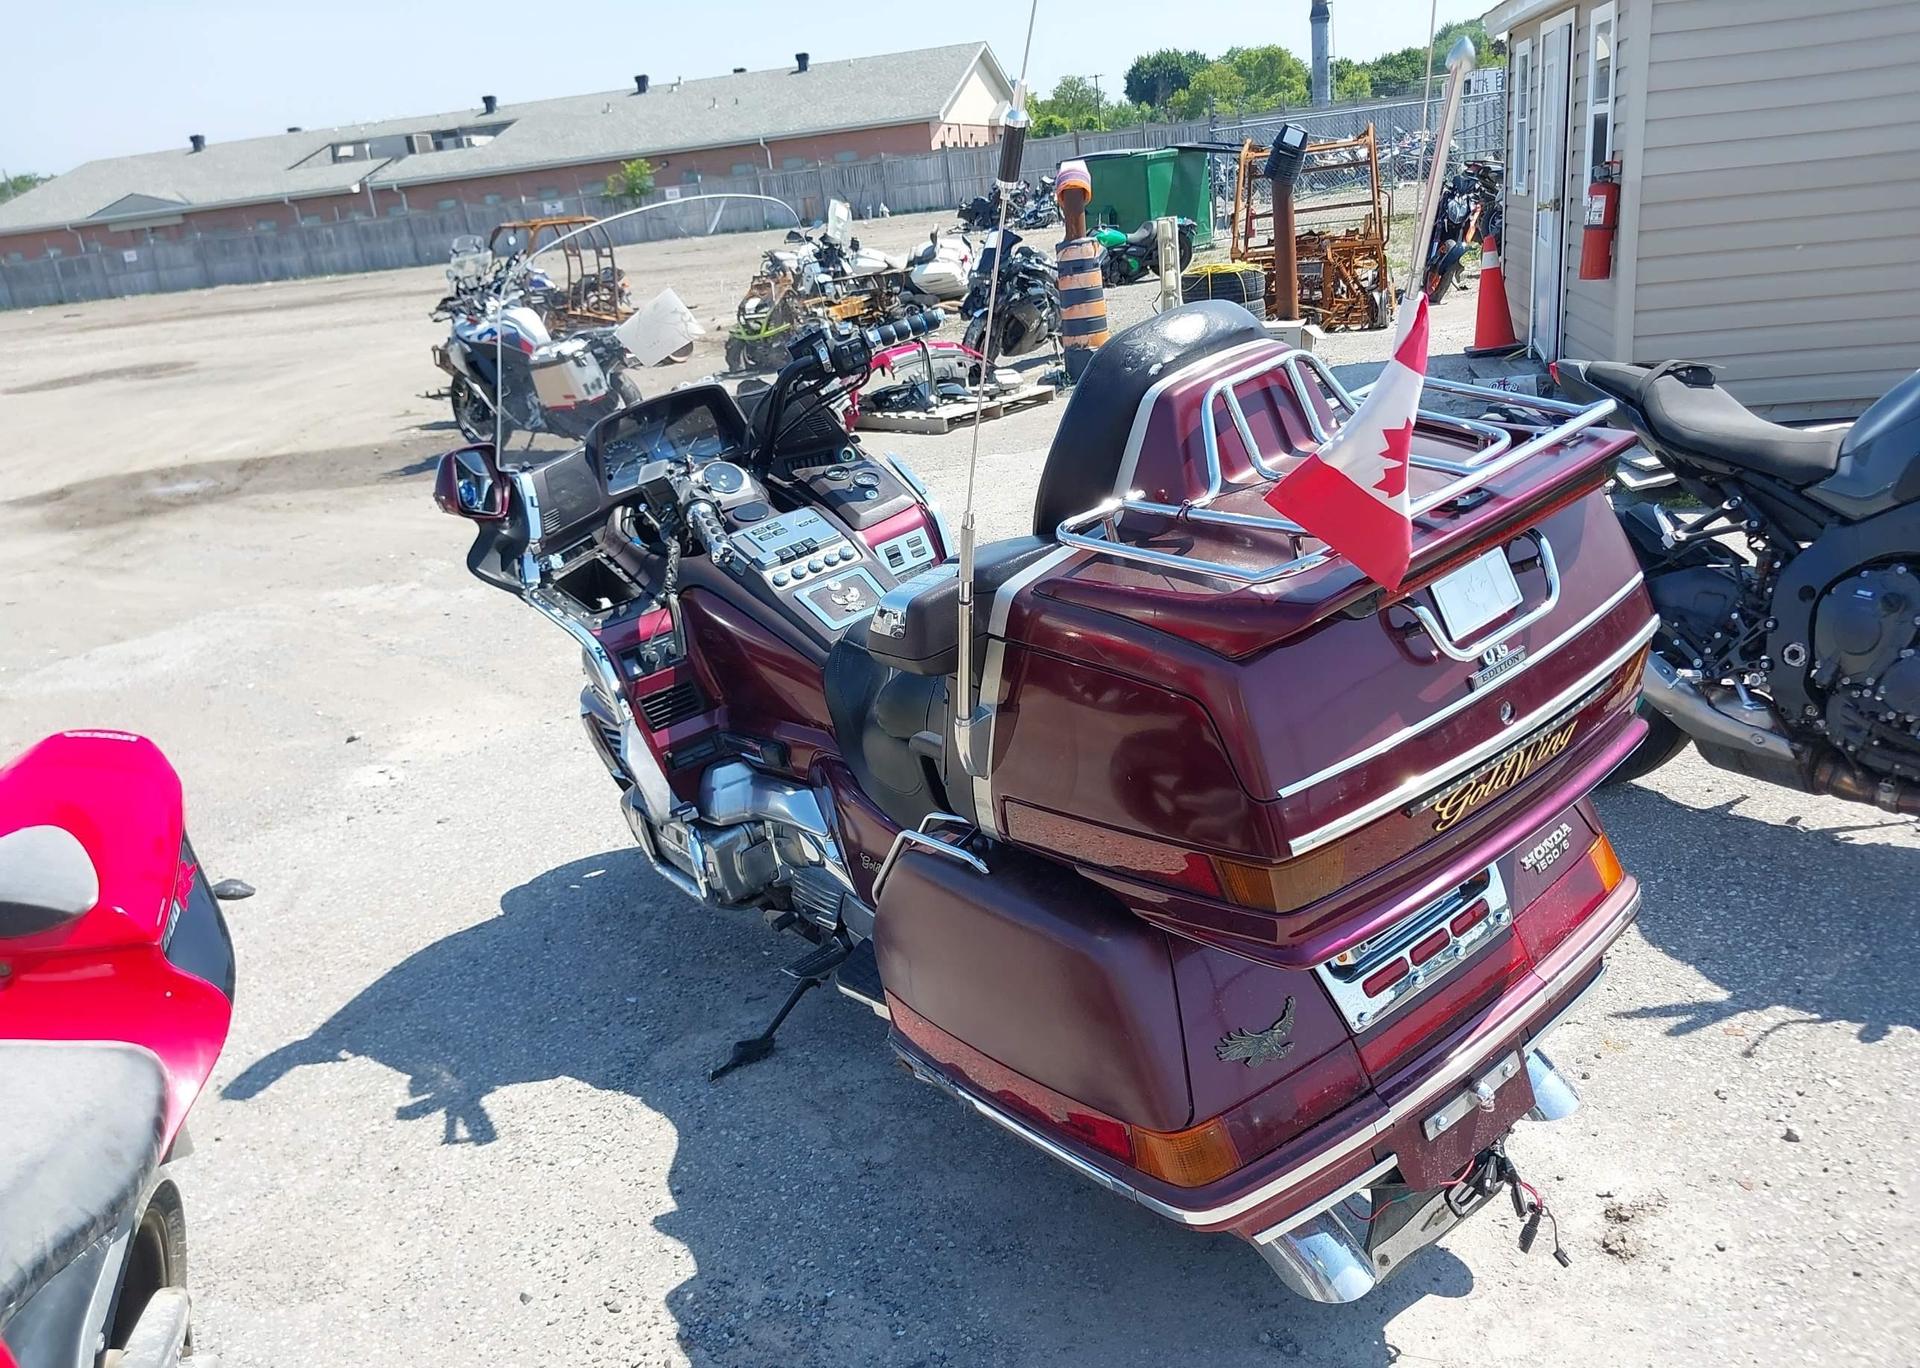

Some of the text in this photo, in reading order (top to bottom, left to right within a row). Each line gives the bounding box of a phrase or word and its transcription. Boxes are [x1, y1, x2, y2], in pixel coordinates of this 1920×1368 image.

[1481, 653, 1520, 683] EDITION
[1520, 822, 1573, 871] HONDA
[1536, 839, 1571, 874] 1500/6
